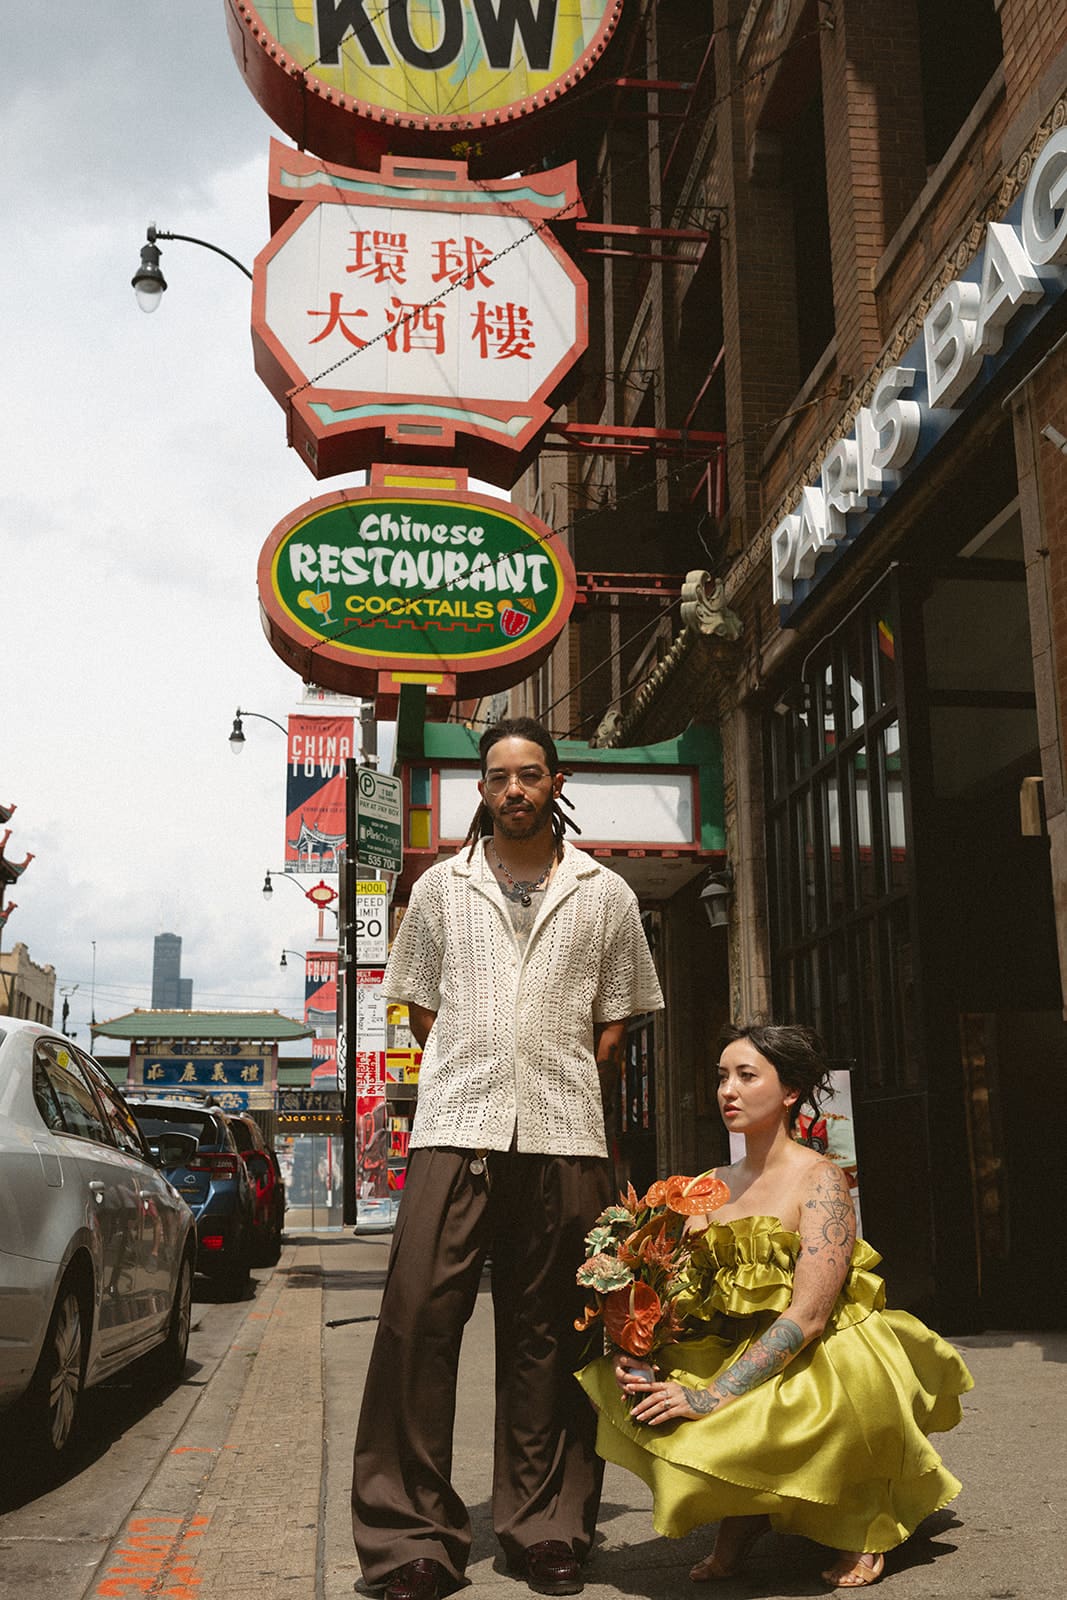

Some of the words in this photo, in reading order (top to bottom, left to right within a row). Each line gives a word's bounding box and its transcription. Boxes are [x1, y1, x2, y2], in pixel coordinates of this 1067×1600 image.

[318, 0, 559, 71] KOW
[345, 230, 495, 291] 環球
[306, 292, 536, 360] 大酒樓
[771, 366, 921, 605] PARIS
[358, 513, 485, 546] Chinese
[289, 543, 549, 594] RESTAURANT
[345, 595, 494, 619] COCKTAILS
[292, 735, 350, 758] CHINA
[291, 756, 347, 779] TOWN
[367, 854, 382, 866] 535
[356, 881, 384, 893] CHOOL
[357, 897, 384, 907] PEED
[357, 908, 379, 917] IMIT
[356, 919, 382, 938] 20
